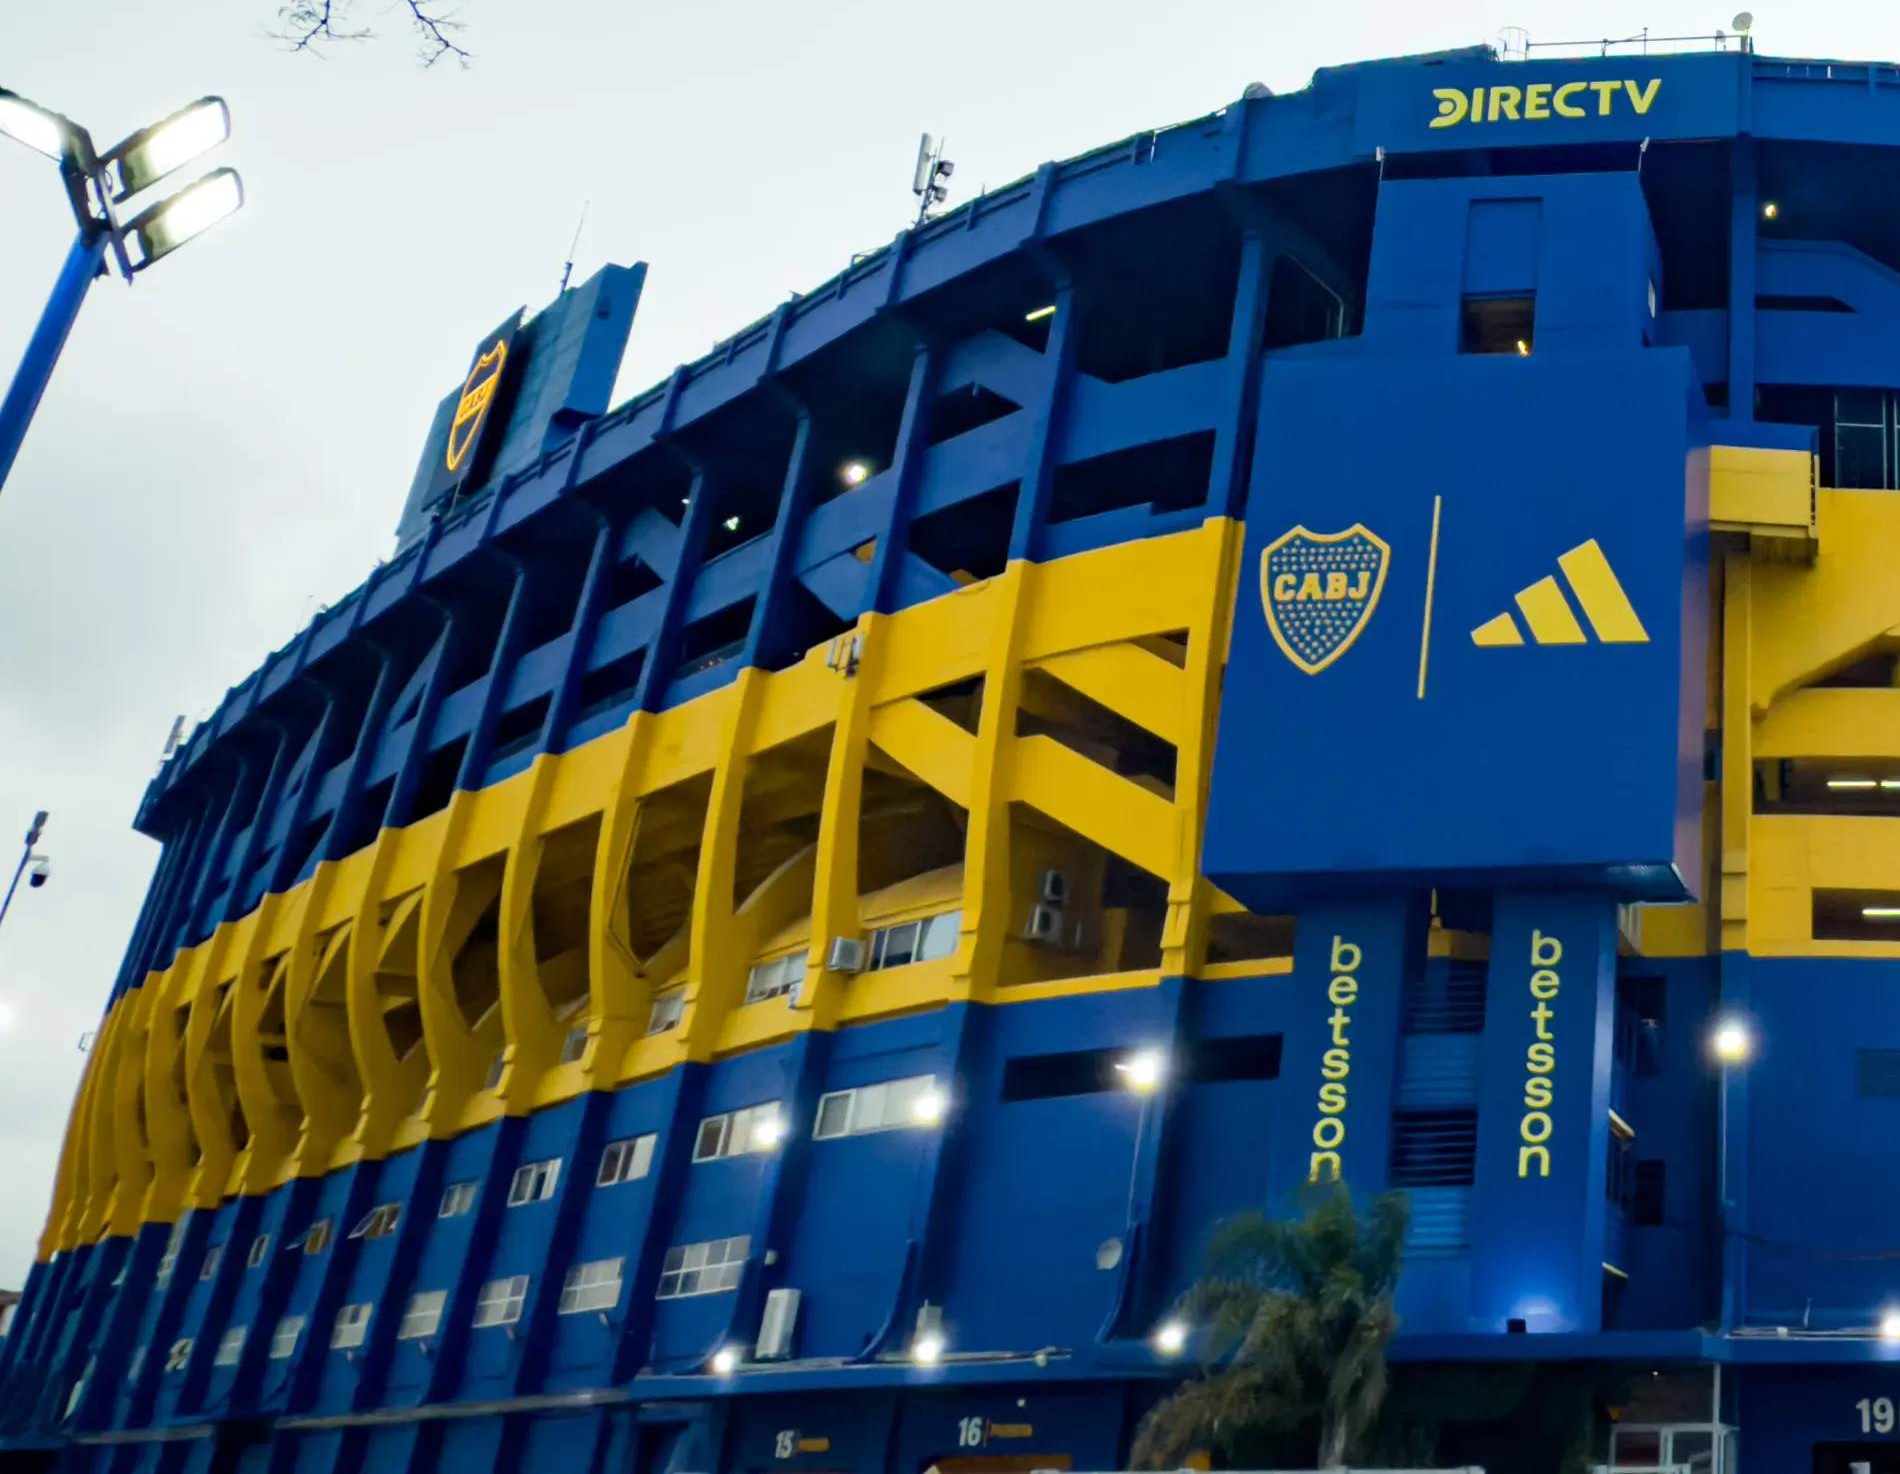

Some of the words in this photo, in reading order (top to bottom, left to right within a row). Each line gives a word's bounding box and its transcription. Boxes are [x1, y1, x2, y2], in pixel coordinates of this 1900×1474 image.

[1429, 78, 1662, 129] DIRECTV
[1274, 571, 1371, 602] CABJ
[1309, 935, 1362, 1183] betsson
[1518, 928, 1564, 1178] betsson
[958, 1416, 982, 1447] 16
[1855, 1397, 1895, 1433] 19
